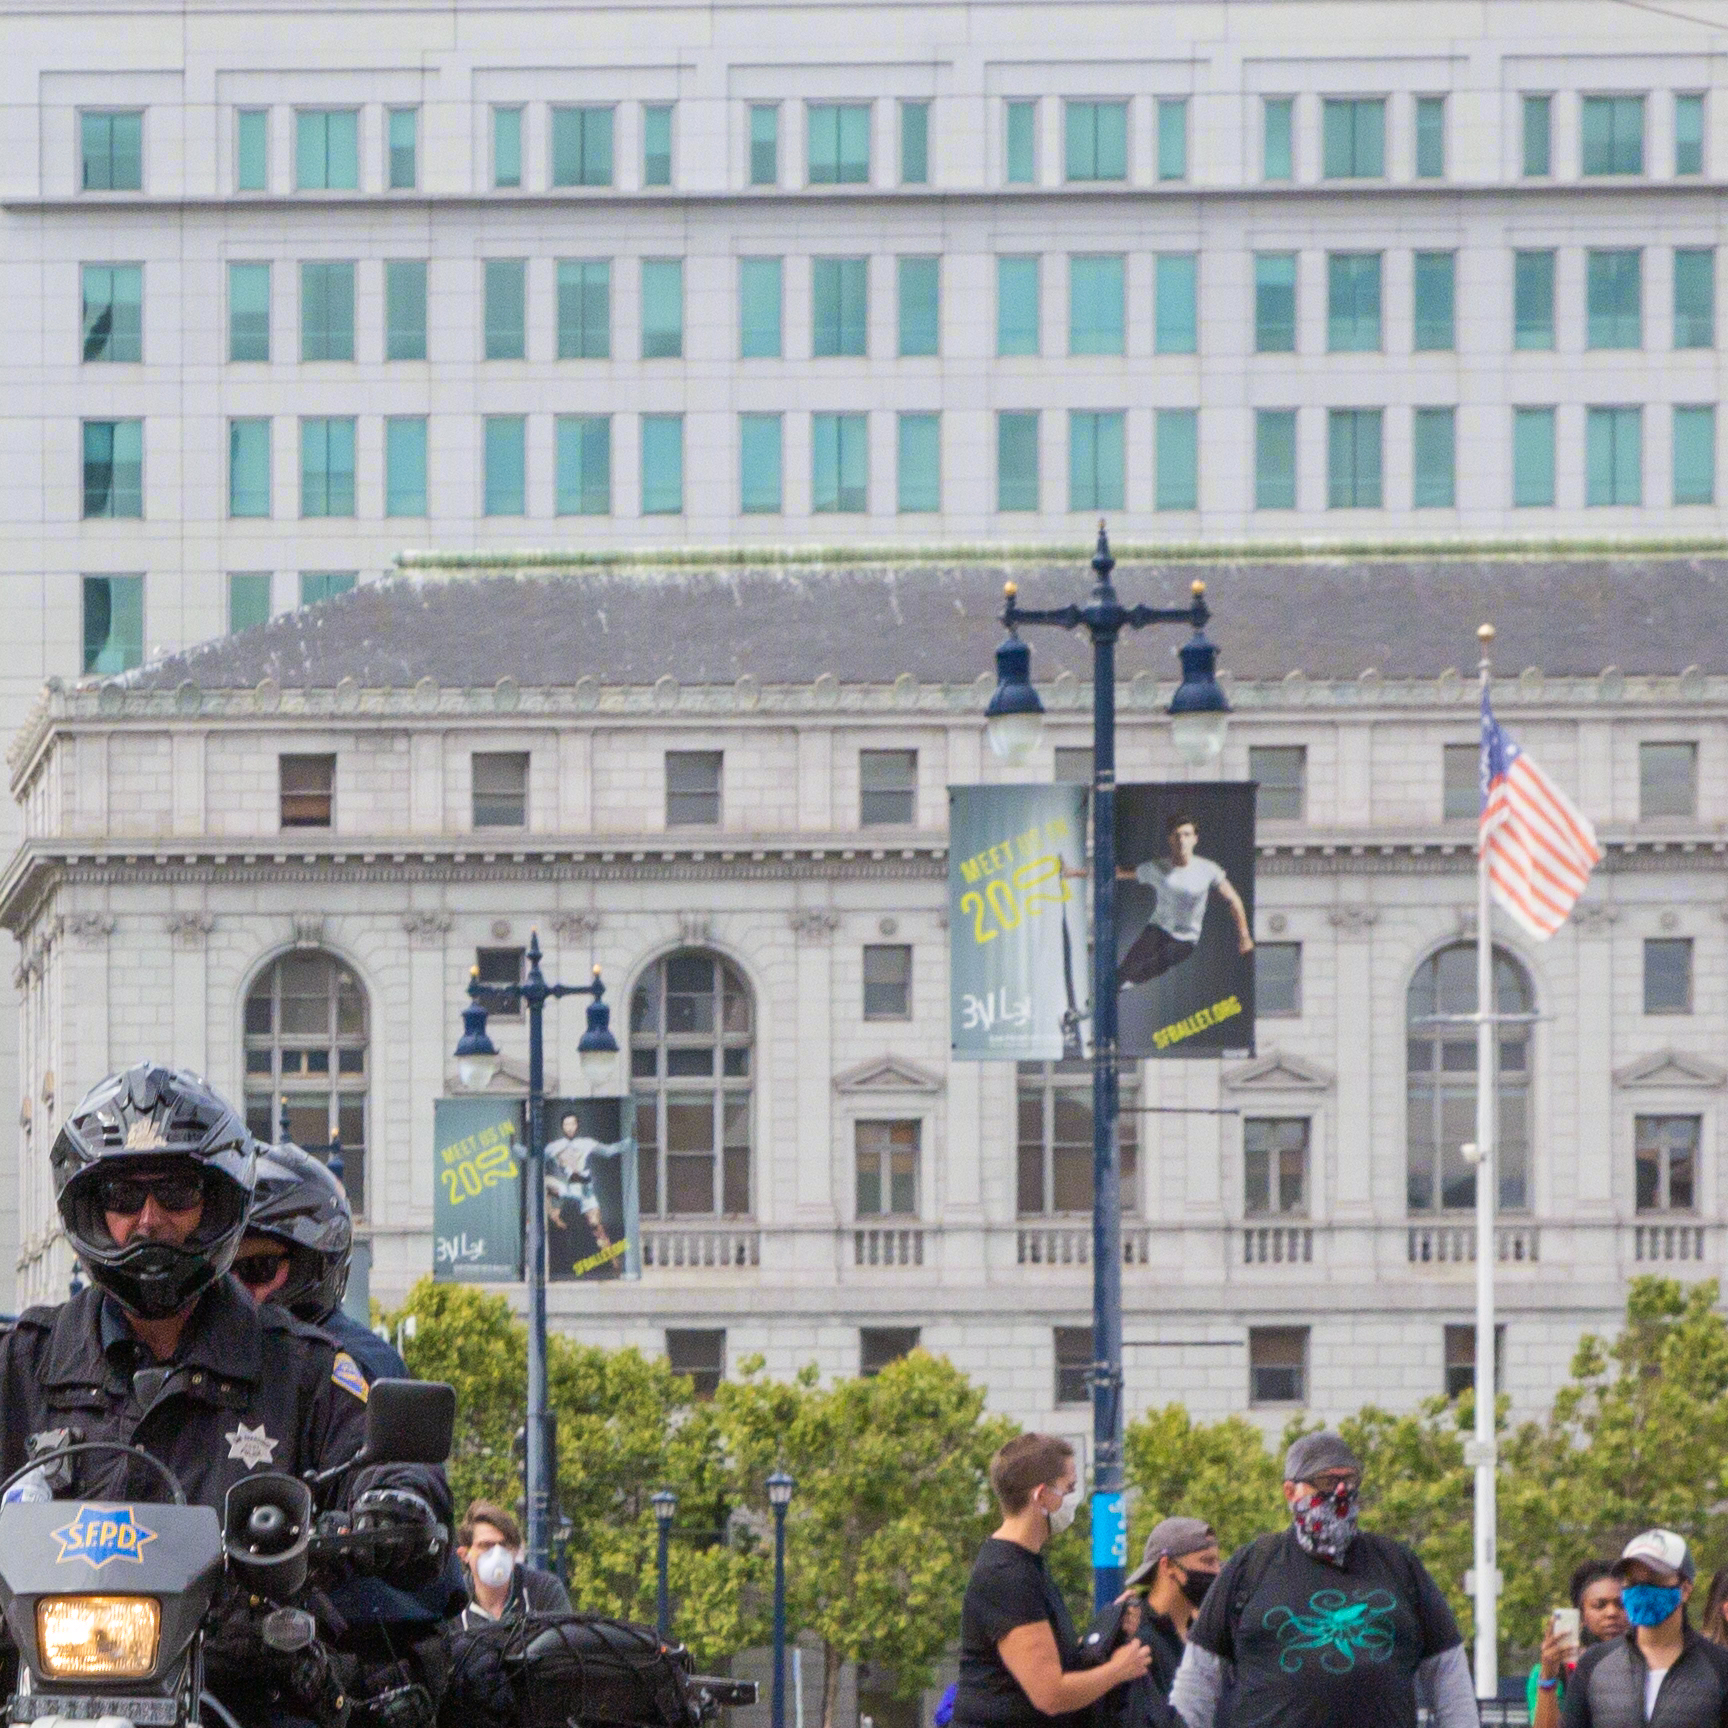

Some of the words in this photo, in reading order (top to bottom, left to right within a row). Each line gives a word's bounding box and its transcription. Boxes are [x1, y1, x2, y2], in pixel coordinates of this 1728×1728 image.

[960, 840, 1015, 884] MEET
[1016, 827, 1044, 857] US
[441, 1134, 476, 1165] MEET
[66, 1520, 137, 1551] S.F.P.D.
